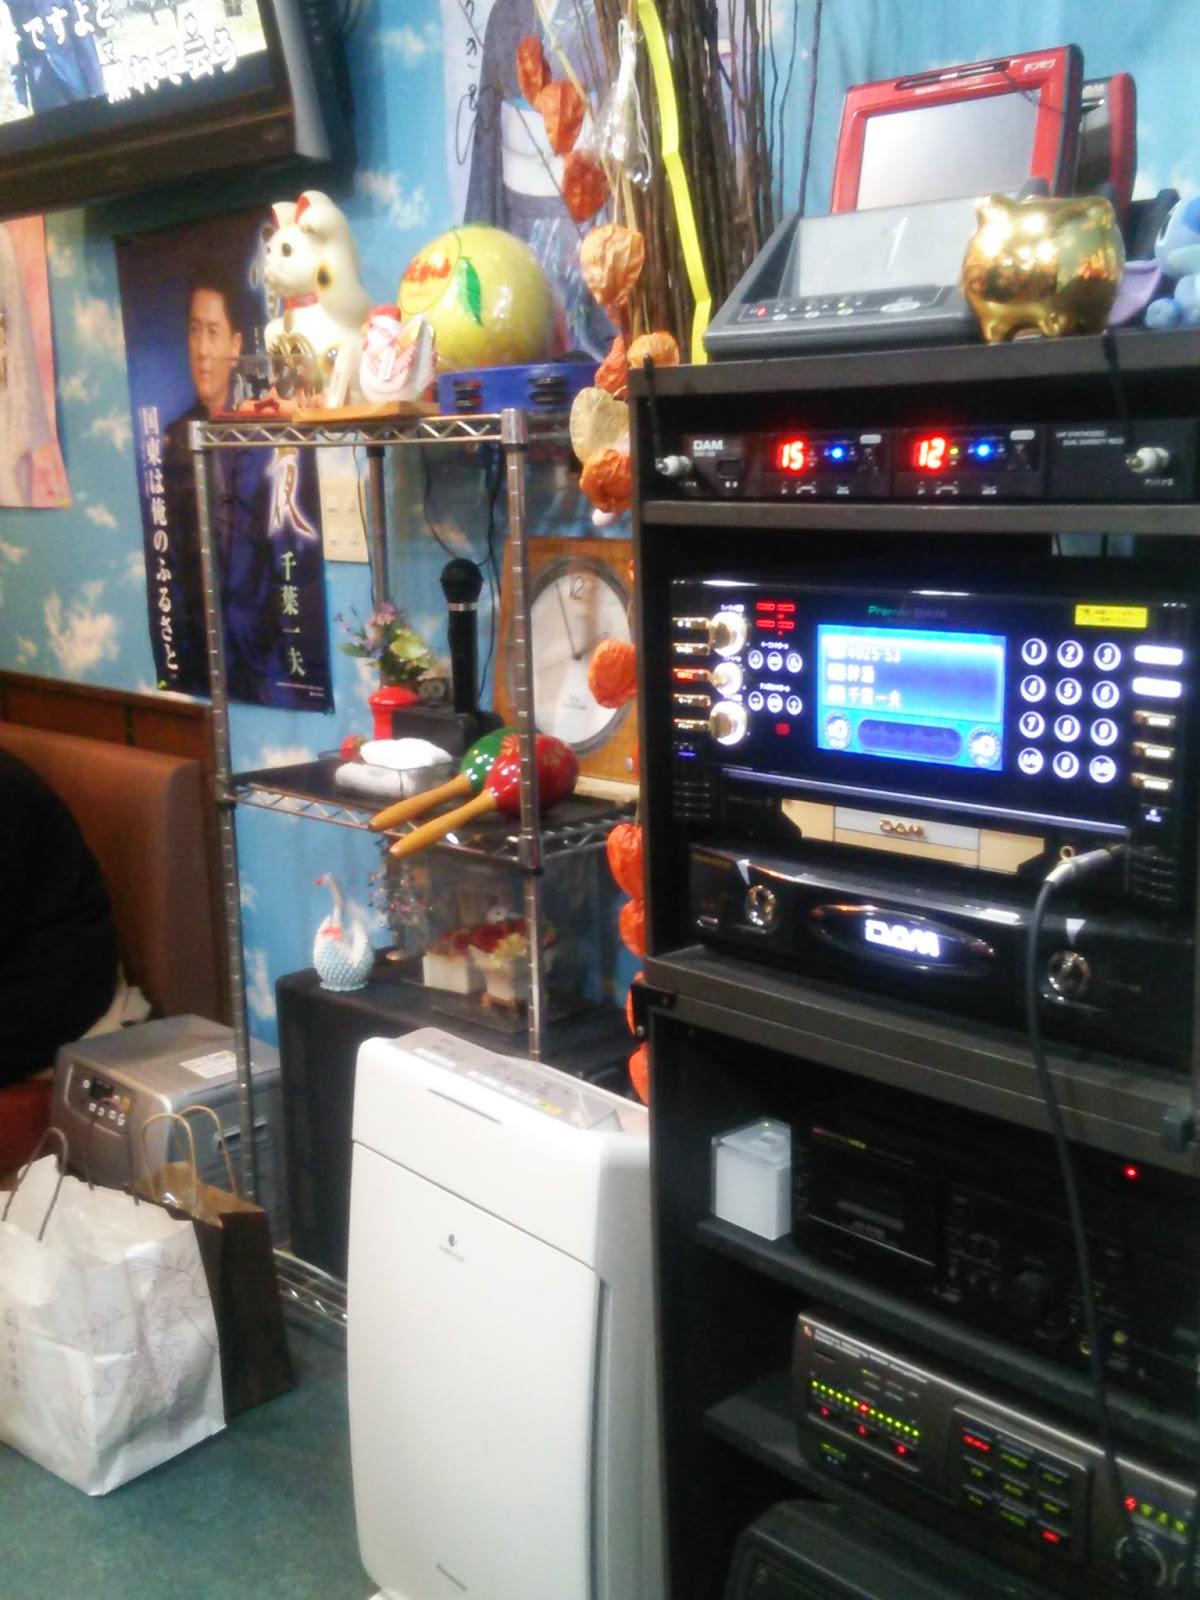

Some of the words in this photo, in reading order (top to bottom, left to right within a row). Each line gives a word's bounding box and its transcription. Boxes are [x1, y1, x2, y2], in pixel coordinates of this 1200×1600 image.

[693, 440, 724, 451] DAM
[780, 441, 805, 471] 15
[918, 437, 946, 469] 12
[569, 576, 585, 600] 12
[281, 551, 306, 677] 千葉一夫
[865, 919, 940, 958] DAM
